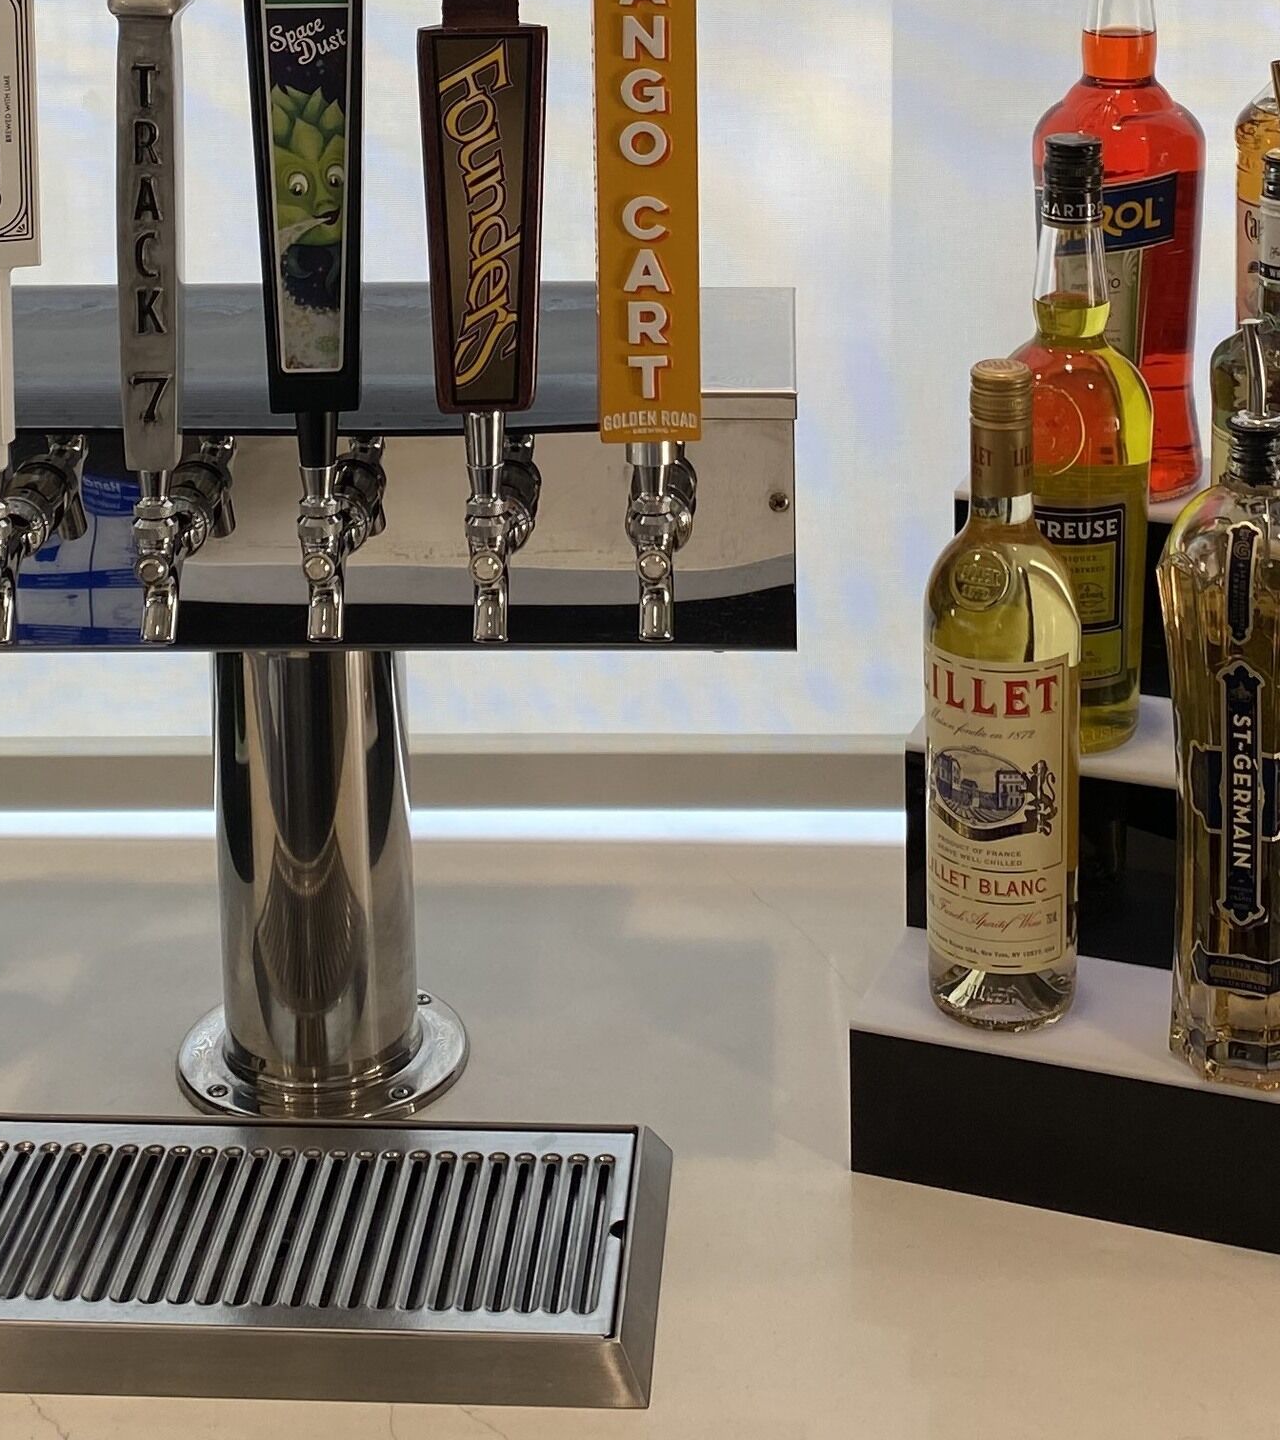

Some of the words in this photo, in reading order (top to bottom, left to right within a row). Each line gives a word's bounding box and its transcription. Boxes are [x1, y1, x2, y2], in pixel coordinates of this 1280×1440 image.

[269, 18, 325, 53] Space
[293, 28, 347, 65] Dust
[3, 93, 12, 112] WITH
[4, 113, 12, 143] BREWED
[130, 62, 167, 336] TRACK
[437, 38, 522, 389] Founders
[1100, 197, 1161, 237] ROL
[621, 195, 671, 400] CART
[128, 371, 173, 424] 7
[603, 410, 657, 431] GOLDEN
[661, 410, 697, 428] ROAD
[1036, 518, 1118, 540] TREUSE
[931, 662, 1058, 718] ILLET
[960, 854, 981, 863] WELL
[984, 859, 1023, 867] CHILLED
[973, 847, 983, 855] OF
[931, 856, 970, 890] ILLET
[979, 877, 1047, 897] BLANC
